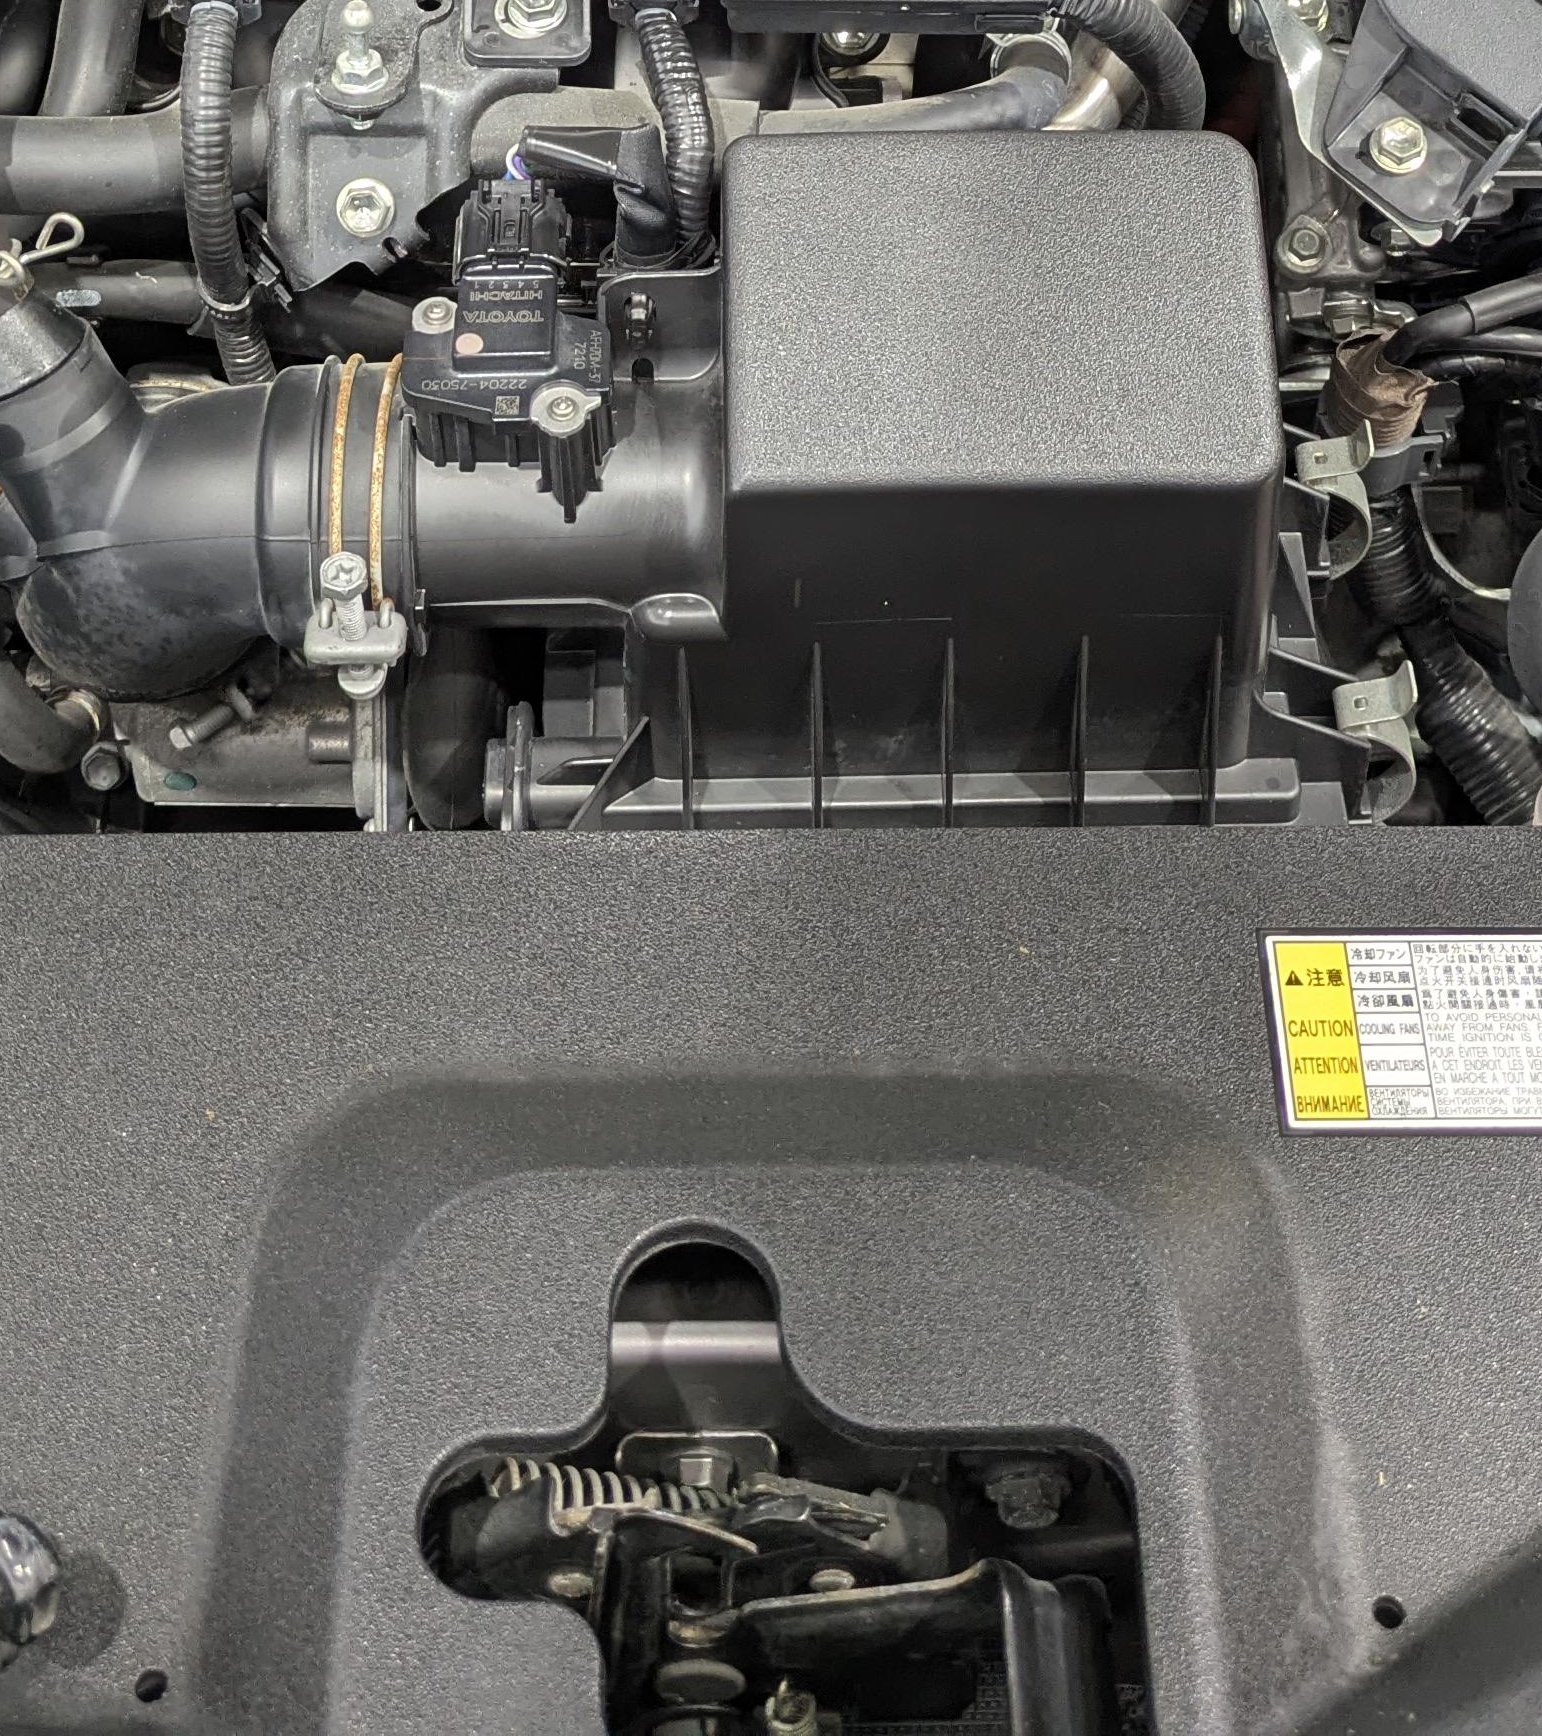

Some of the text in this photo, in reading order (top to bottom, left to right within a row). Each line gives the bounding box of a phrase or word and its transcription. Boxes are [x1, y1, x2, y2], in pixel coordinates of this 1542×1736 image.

[469, 290, 543, 301] HITACHI
[462, 310, 544, 323] TOYOTA
[573, 342, 587, 370] 7210
[421, 378, 528, 391] 22204-75030
[1350, 948, 1407, 960] 冷却ファン
[1306, 968, 1345, 986] 注意
[1353, 971, 1411, 984] 冷却风扇
[1424, 1013, 1440, 1022] TO
[1445, 1013, 1479, 1022] AVOID
[1485, 1013, 1542, 1022] PERSONAL
[1288, 1020, 1353, 1037] CAUTION
[1359, 1023, 1420, 1035] COOLING FANS
[1426, 1023, 1457, 1032] AWAY
[1462, 1023, 1494, 1032] FROM
[1428, 1033, 1455, 1042] TIME
[1462, 1033, 1514, 1042] IGNITION
[1521, 1033, 1532, 1041] IS
[1429, 1047, 1454, 1058] POUR
[1492, 1047, 1521, 1057] TOUTE
[1292, 1057, 1358, 1074] ATTENTION
[1364, 1060, 1425, 1071] VENTILATEURS
[1442, 1060, 1460, 1071] CET
[1507, 1060, 1524, 1070] LES
[1433, 1073, 1446, 1084] EN
[1450, 1072, 1487, 1084] MARCHE
[1502, 1072, 1526, 1083] TOUT
[1369, 1088, 1429, 1097] ВЕНТИЛЯТОРЫ
[1296, 1096, 1364, 1113] ВНИМАНИЕ
[1370, 1098, 1410, 1106] СИСТЕМЫ
[1372, 1107, 1428, 1115] ОХЛАЖДЕНИЯ
